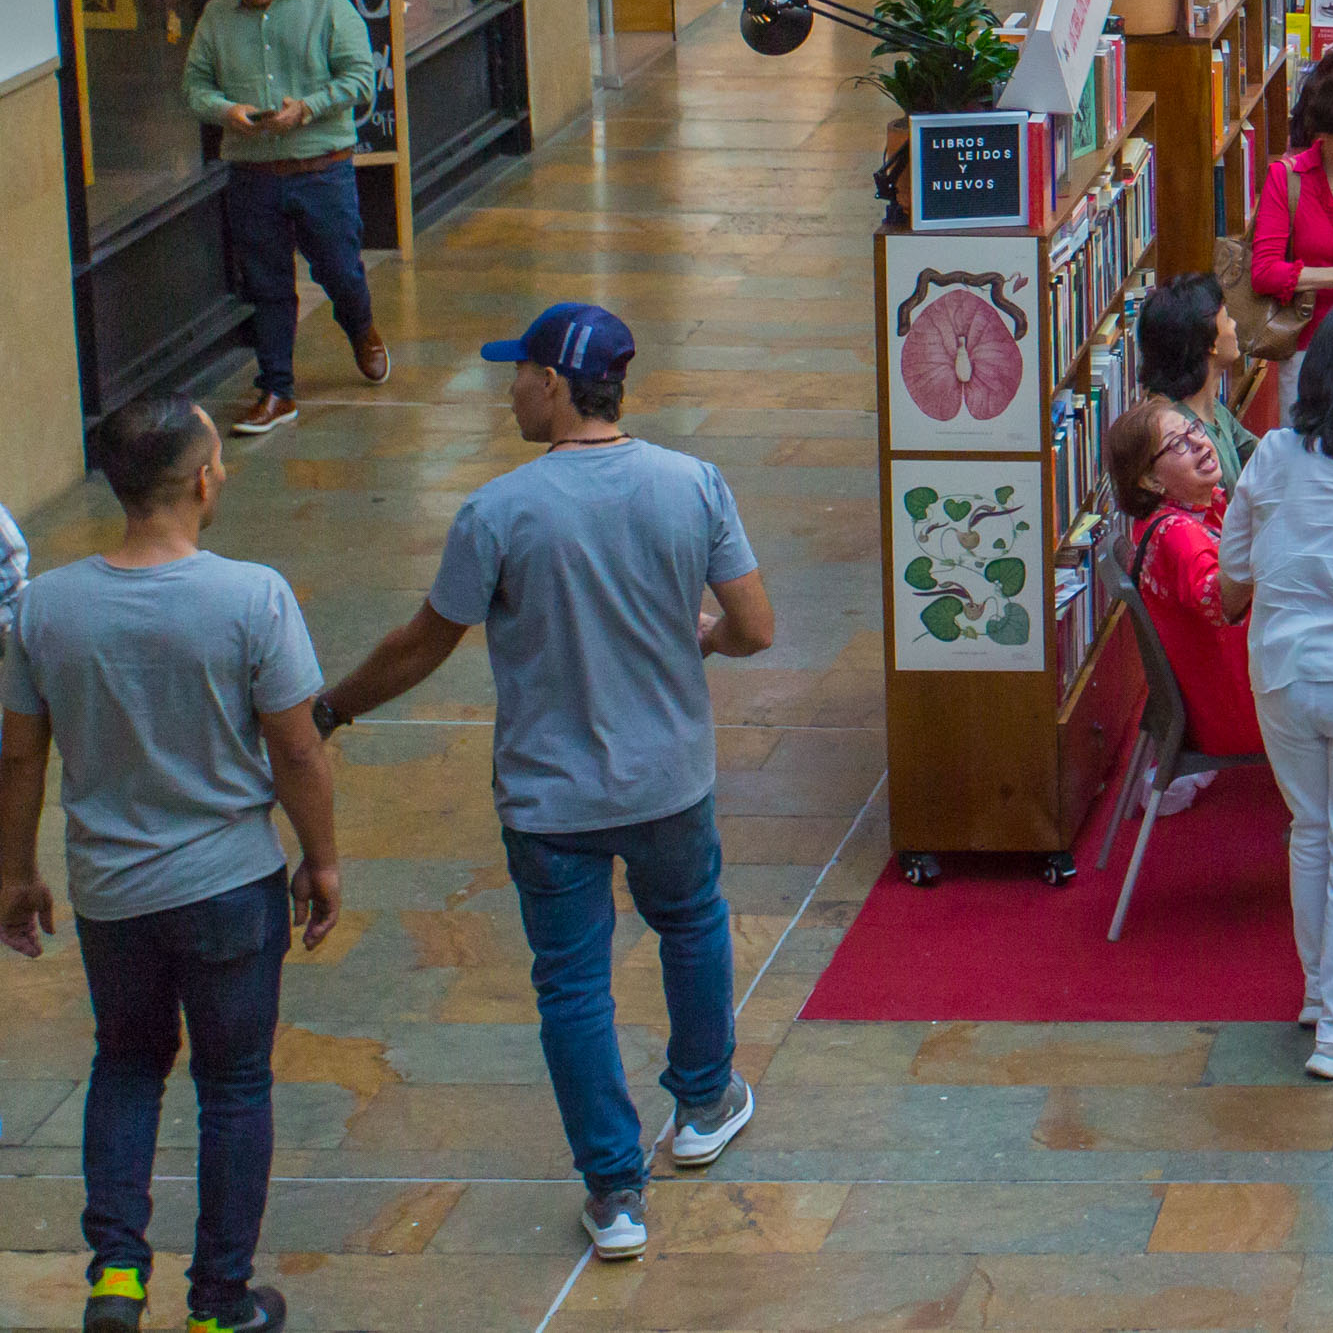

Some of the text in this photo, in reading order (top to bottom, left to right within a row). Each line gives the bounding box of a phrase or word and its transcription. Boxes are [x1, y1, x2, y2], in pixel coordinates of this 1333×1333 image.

[932, 137, 984, 149] LIBROS
[958, 149, 1012, 161] LEIDOS
[959, 164, 967, 174] Y
[932, 179, 994, 191] NUEVOS
